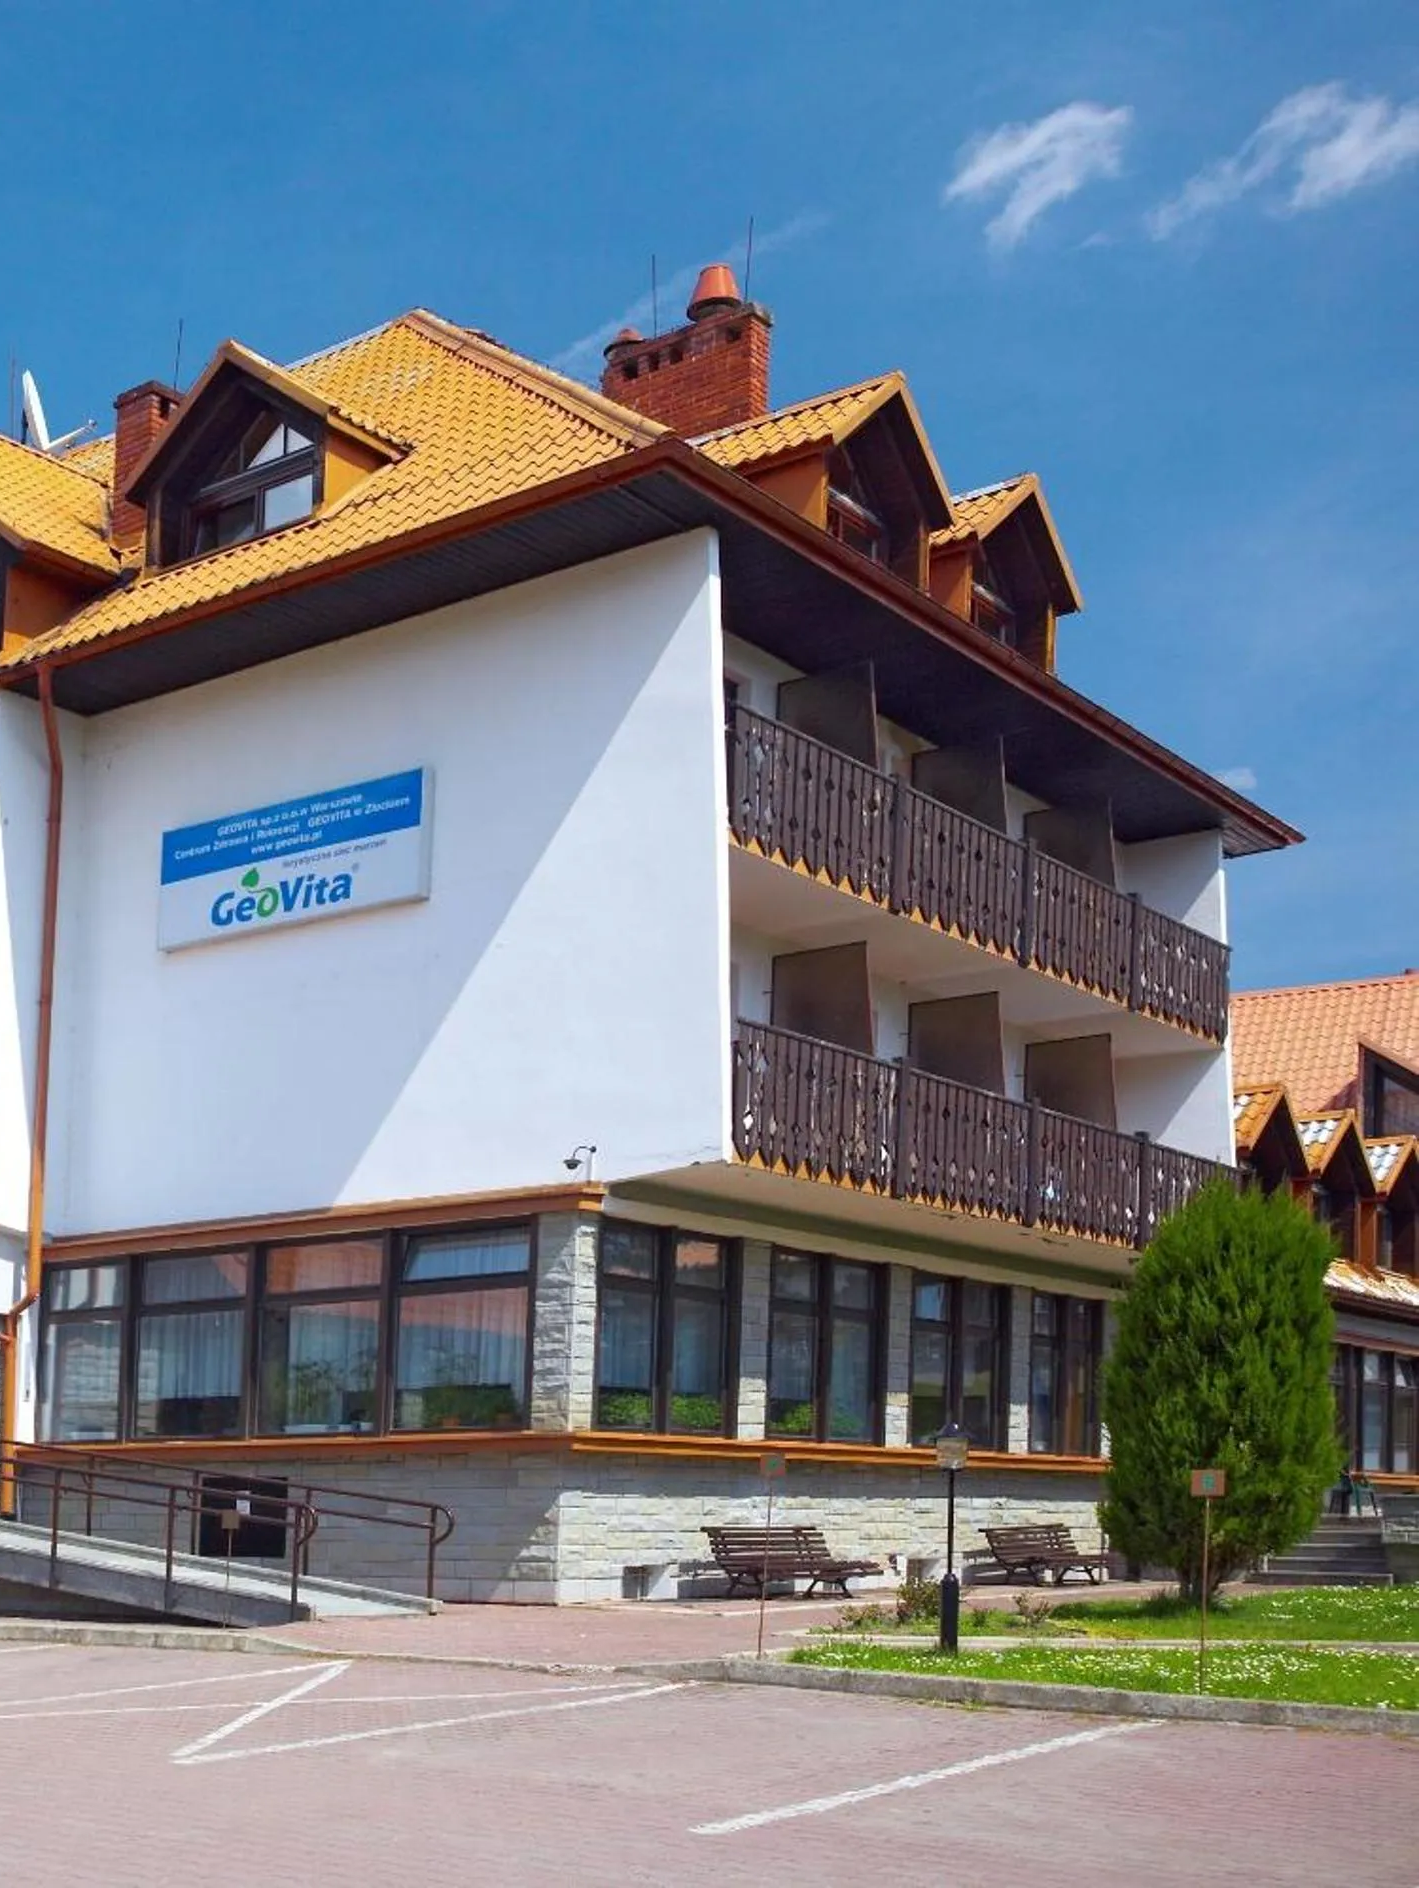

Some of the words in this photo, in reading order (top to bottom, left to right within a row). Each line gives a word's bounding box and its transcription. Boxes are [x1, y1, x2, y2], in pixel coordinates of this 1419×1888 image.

[217, 818, 258, 837] GEOVITA
[307, 808, 351, 828] GEOVITA
[211, 873, 352, 926] GeoVita
